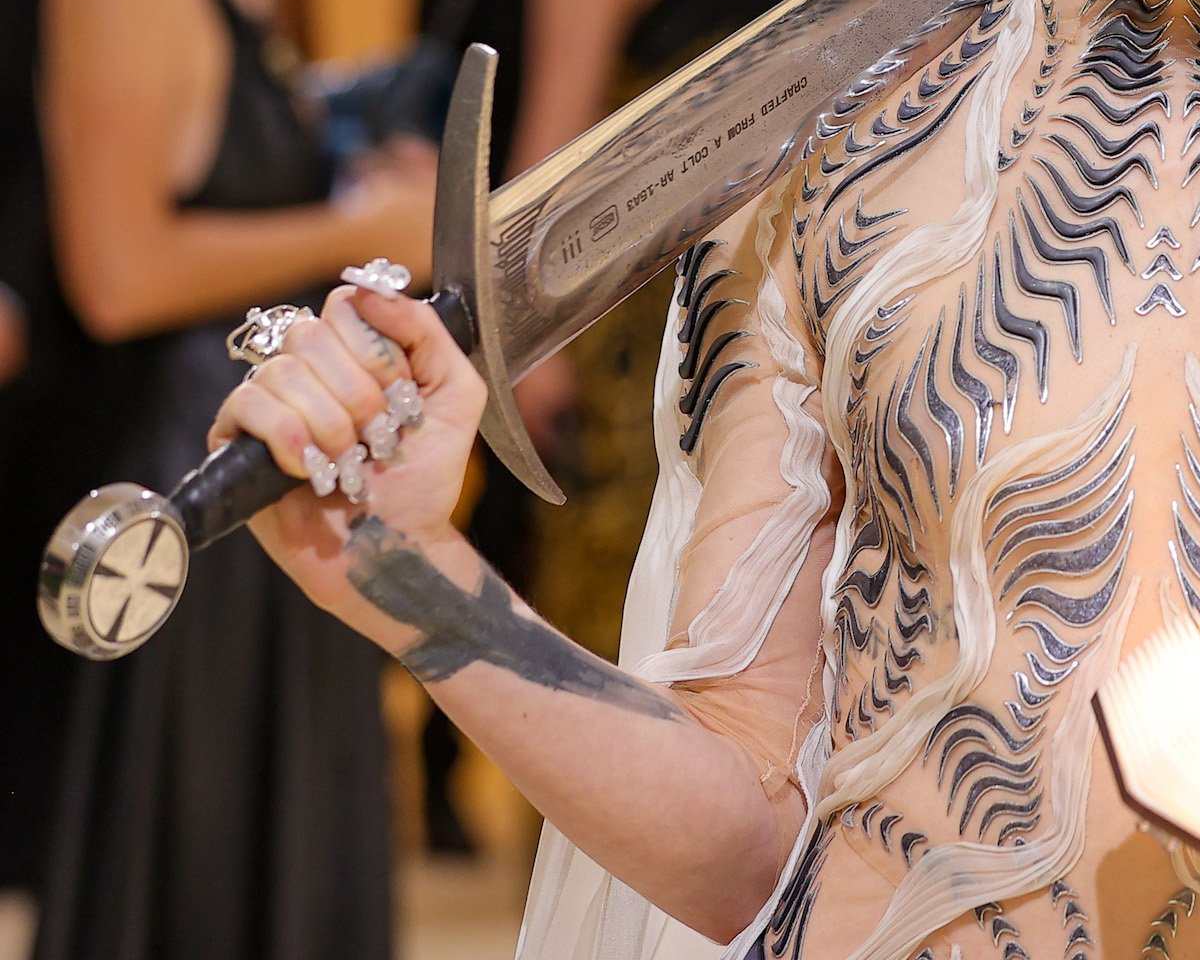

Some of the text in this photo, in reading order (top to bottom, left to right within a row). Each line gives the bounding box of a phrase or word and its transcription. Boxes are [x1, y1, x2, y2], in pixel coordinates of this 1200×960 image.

[626, 76, 808, 212] CRAFTED FROM A COLT AR-15A3
